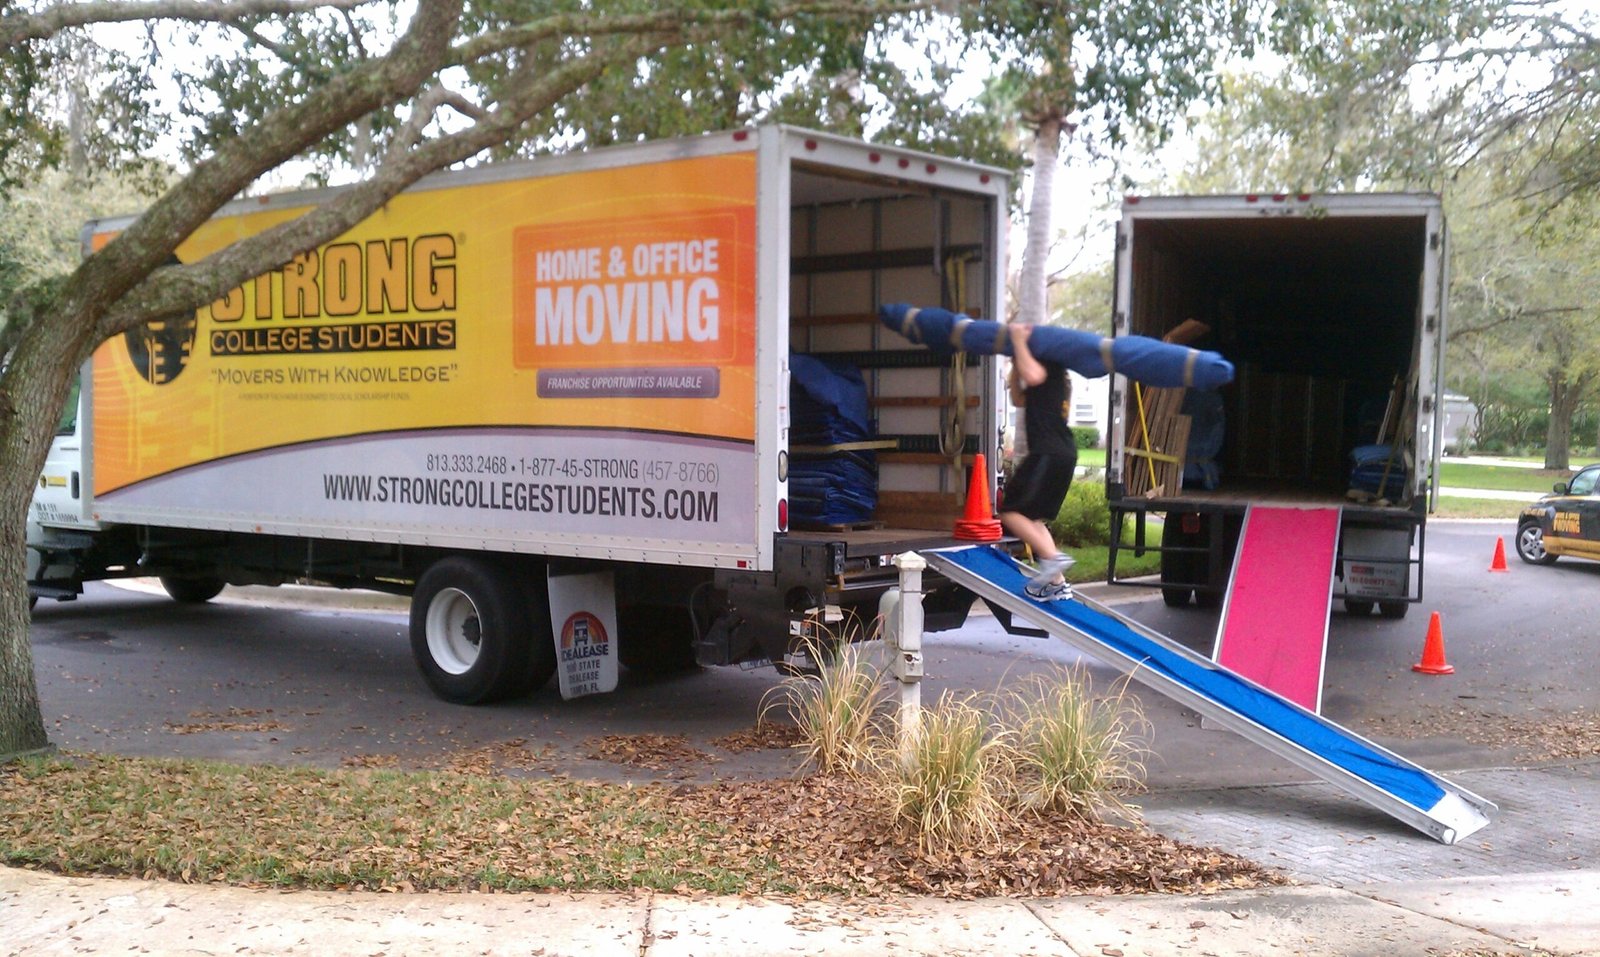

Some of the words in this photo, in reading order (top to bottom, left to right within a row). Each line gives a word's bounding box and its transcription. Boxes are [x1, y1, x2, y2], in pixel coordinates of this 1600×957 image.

[536, 247, 601, 283] HOME
[608, 245, 626, 278] &
[633, 238, 718, 277] OFFICE
[535, 277, 719, 346] MOVING
[211, 328, 313, 352] COLLEGE
[318, 321, 455, 349] STUDENTS
[547, 377, 590, 390] FRANCHISE
[592, 376, 654, 389] OPPORTUNITIES
[656, 375, 702, 389] AVAILABLE
[426, 453, 507, 475] 813.333.2468
[520, 457, 639, 479] 1-877-45-STRONG
[642, 460, 720, 487] (457-8766)
[322, 472, 719, 523] WWW.STRONGCOLLEGESTUDENTS.COM
[561, 645, 608, 661] DEALEASE
[579, 660, 600, 670] STATE
